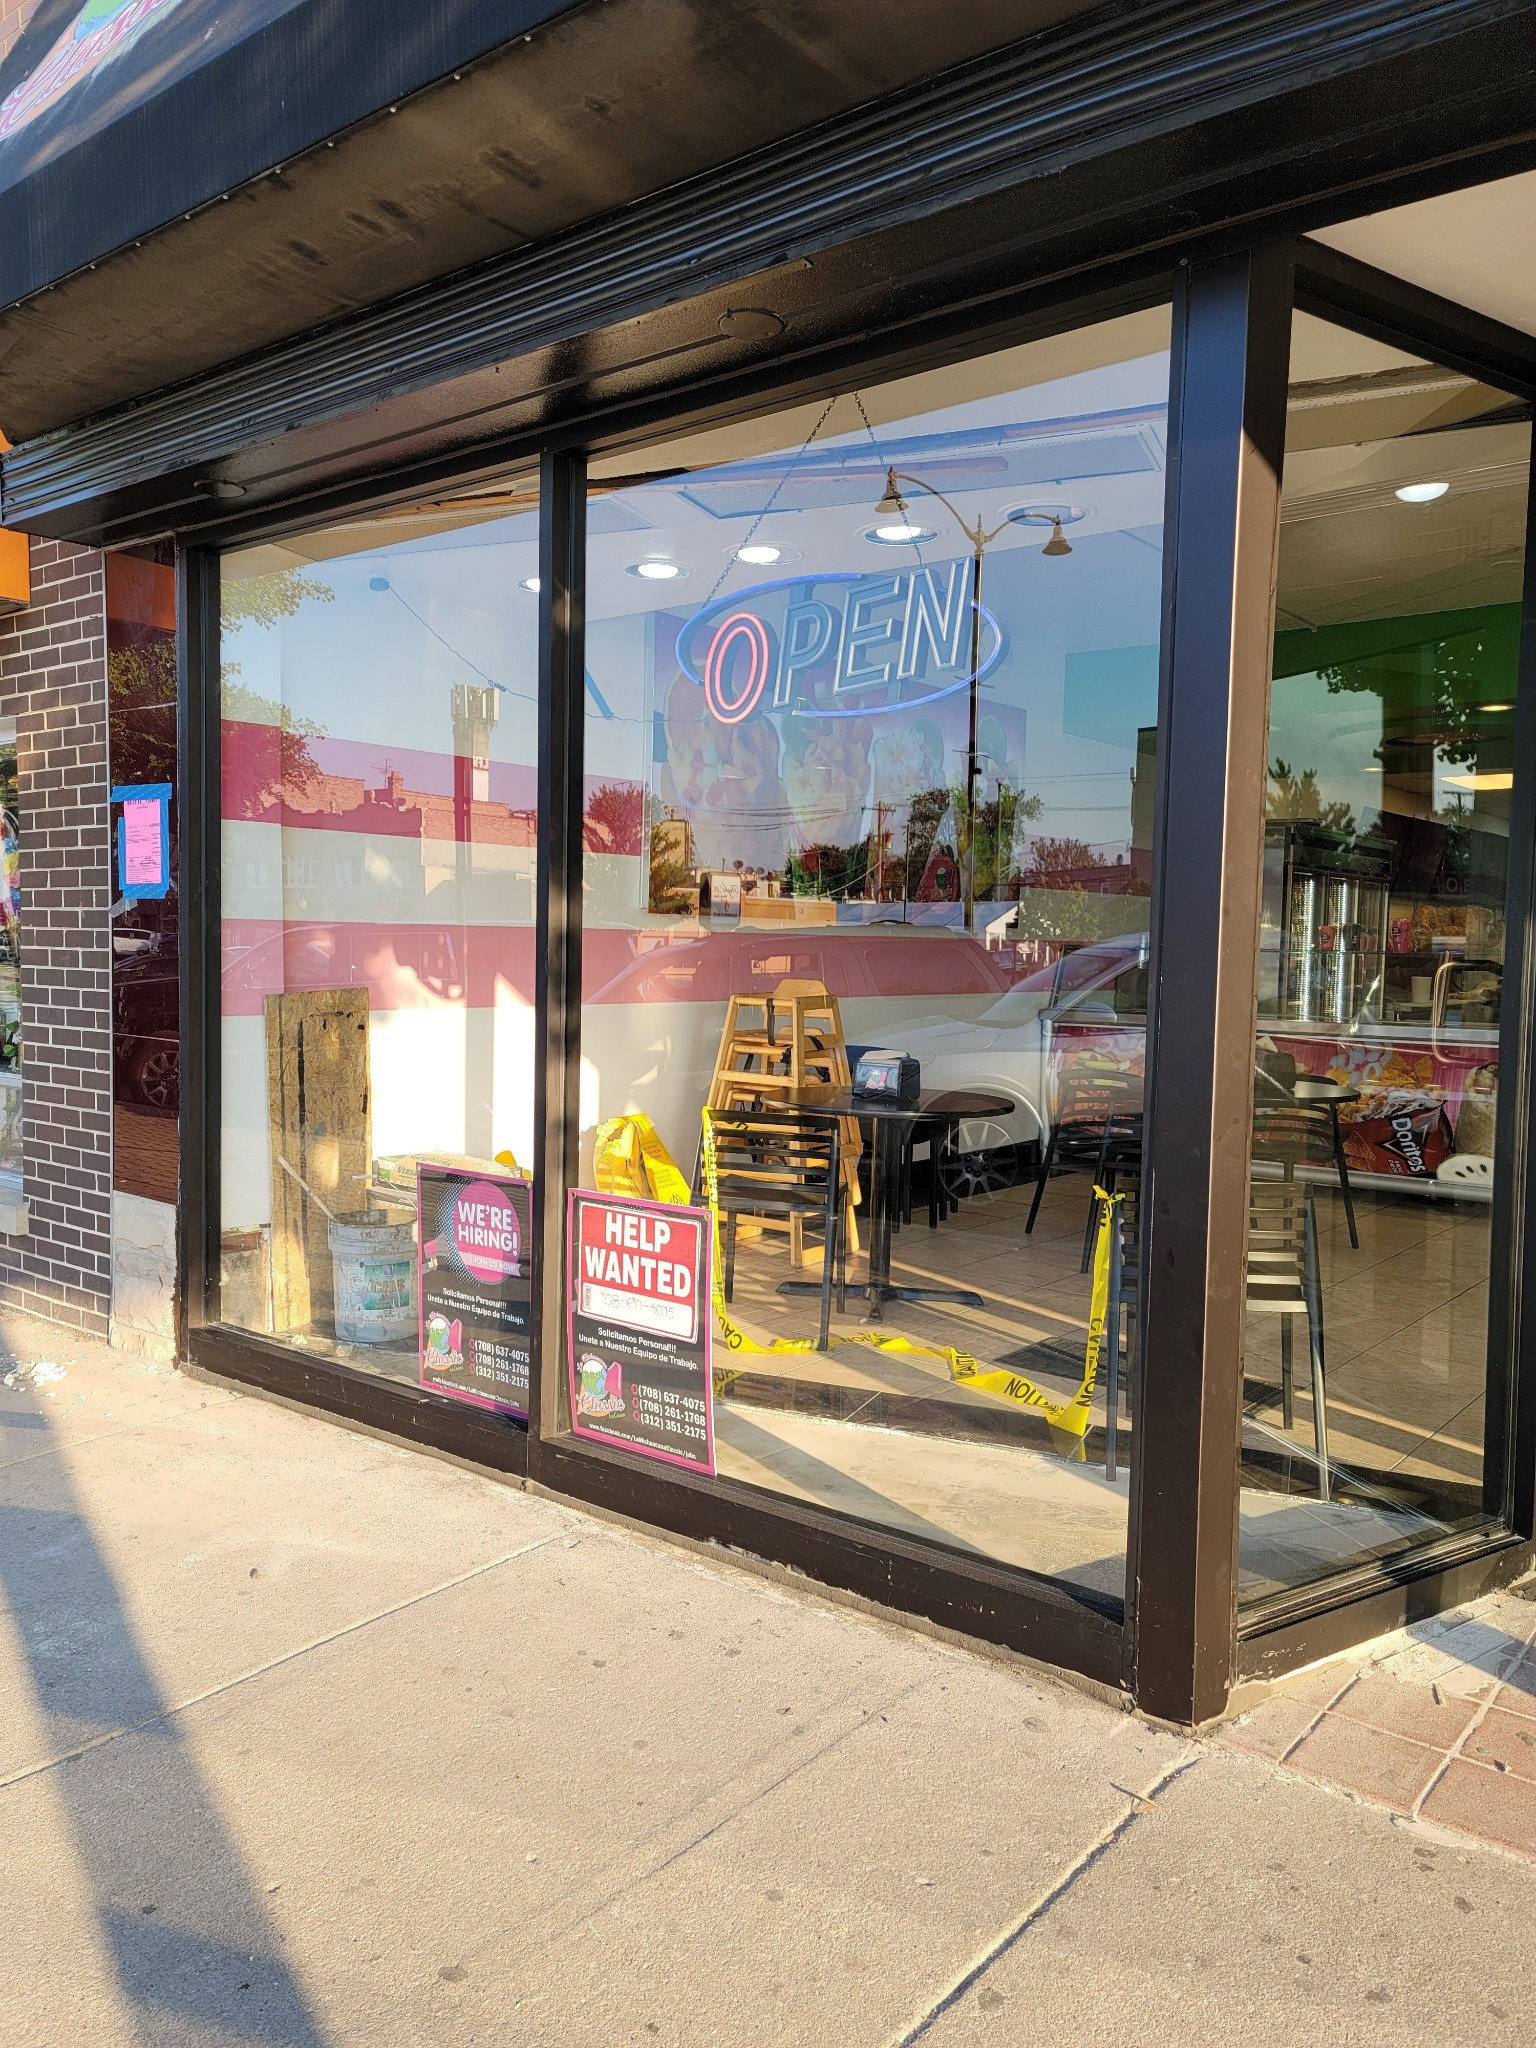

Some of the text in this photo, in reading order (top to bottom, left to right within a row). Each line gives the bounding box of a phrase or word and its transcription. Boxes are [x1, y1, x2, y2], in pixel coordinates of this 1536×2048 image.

[704, 556, 973, 725] OPEN
[1391, 1117, 1427, 1172] Doritos
[457, 1200, 513, 1232] WE'RE
[458, 1224, 518, 1257] HIRING!
[605, 1211, 671, 1253] HELP
[473, 1257, 517, 1272] JOIN US NOW!
[584, 1244, 692, 1298] WANTED
[442, 1287, 476, 1303] Solicitamos
[448, 1298, 471, 1311] Nuestro
[471, 1304, 492, 1317] Equipo
[492, 1309, 500, 1318] de
[501, 1311, 525, 1325] Trabajo.
[474, 1339, 529, 1363] (708) 637-4075
[578, 1333, 599, 1346] Unete
[604, 1339, 632, 1354] Nuestro
[632, 1346, 658, 1360] Equipo
[658, 1353, 668, 1363] de
[668, 1355, 699, 1370] Trabajo.
[597, 1327, 677, 1353] Solicitamos Personal!!!
[475, 1352, 529, 1376] (708) 261-1768
[475, 1365, 495, 1381] (312)
[495, 1371, 529, 1389] 351-2175
[638, 1384, 706, 1412] (708) 637-4075
[639, 1398, 706, 1427] (708) 261-1768
[640, 1412, 707, 1441] (312) 351-2175
